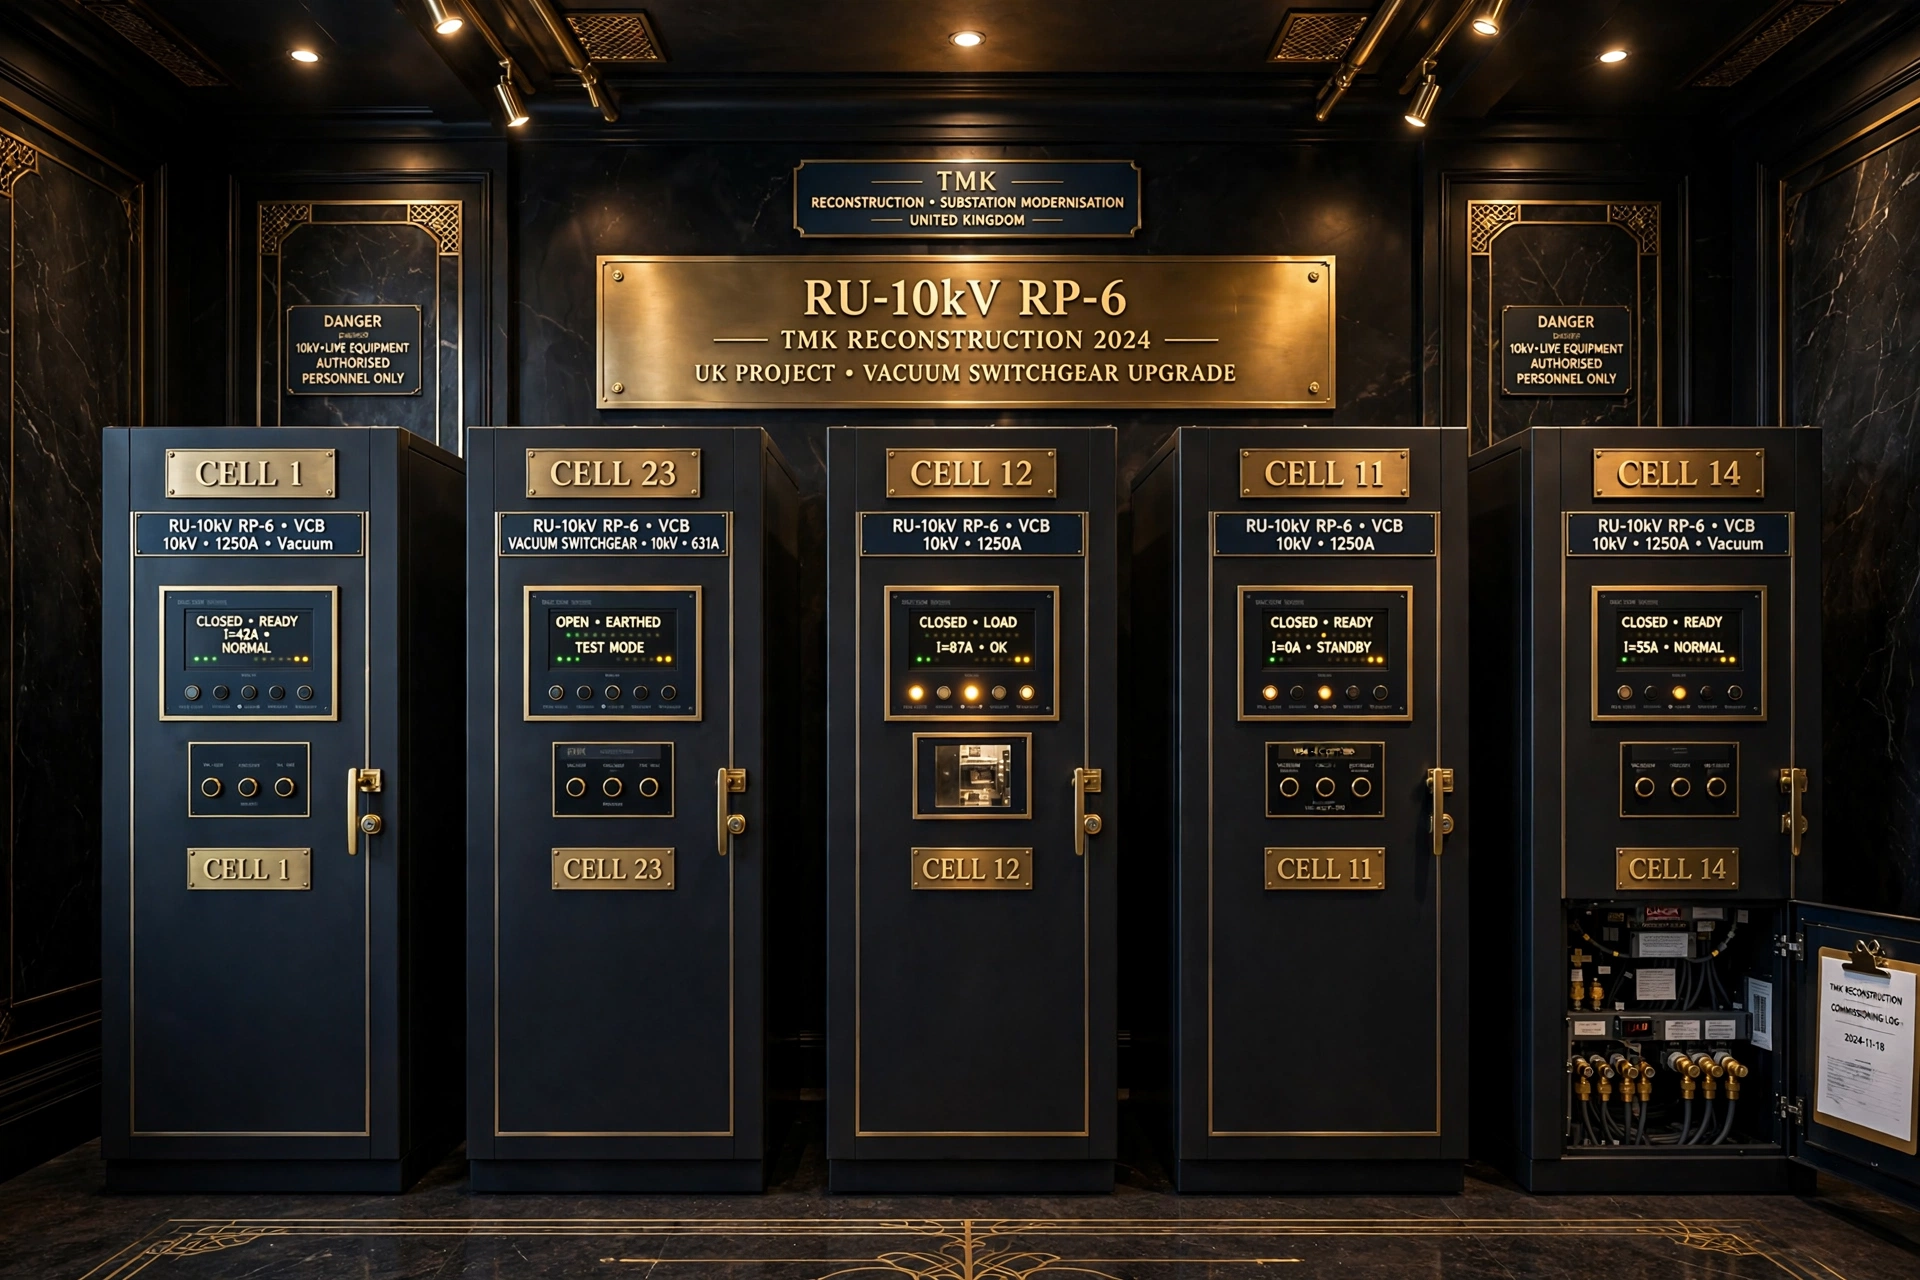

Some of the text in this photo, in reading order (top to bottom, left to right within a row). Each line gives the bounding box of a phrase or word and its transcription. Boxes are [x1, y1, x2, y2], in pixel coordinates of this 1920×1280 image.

[936, 170, 997, 192] TMK
[811, 196, 1124, 209] RECONSTRUCTION SUBSTATION MODERNISATION
[909, 213, 1026, 227] UNITED KINGDOM
[804, 278, 1127, 318] RU-10kV RP-6
[324, 314, 382, 328] DANGER
[1538, 315, 1594, 329] DANGER
[781, 328, 1151, 351] TMK RECONSTRUCTION 2024
[349, 342, 410, 354] EQUIPMENT
[1563, 343, 1624, 355] EQUIPMENT
[316, 357, 391, 369] AUTHORISED
[1530, 358, 1602, 369] AUTHORISED
[302, 372, 405, 384] PERSONNEL ONLY
[695, 363, 1237, 386] UK PROJECT VACUUM SWITCHGEAR UPGRADE
[1516, 373, 1617, 385] PERSONNEL ONLY
[196, 460, 303, 487] CELL 1
[550, 460, 677, 487] CELL 23
[910, 460, 1033, 487] CELL 12
[1264, 460, 1384, 487] CELL 11
[1617, 460, 1741, 487] CELL 14
[169, 518, 326, 533] RU-10kV RP-6 VCB
[533, 518, 690, 533] RU-10kV RP-6 VCB
[892, 518, 1050, 533] RU-10kV RP-6 VCB
[1246, 518, 1403, 533] RU-10kV RP-6 VCB
[1598, 518, 1755, 533] RU-10kV RP-6 VCB
[163, 537, 333, 551] 10kV 1250A Vacuum
[508, 536, 720, 551] VACUUM SWITCHGEAR 10kV 631A
[923, 536, 1022, 551] 10kV 1250A
[1276, 536, 1375, 551] 10kV 1250A
[1593, 536, 1764, 551] 10kV 1250A Vacuum
[196, 615, 298, 628] CLOSED READY
[555, 616, 661, 628] OPEN EARTHED
[919, 616, 1018, 628] CLOSED LOAD
[1270, 616, 1373, 628] CLOSED READY
[1621, 616, 1723, 628] CLOSED READY
[222, 642, 272, 654] NORMAL
[575, 641, 645, 654] TEST MODE
[936, 641, 1008, 654] I=87A OK
[1272, 641, 1372, 654] I=0A STANDBY
[1624, 641, 1724, 653] I=55A NORMAL
[203, 858, 289, 880] CELL 1
[563, 858, 663, 880] CELL 23
[922, 858, 1020, 880] CELL 12
[1277, 858, 1371, 880] CELL 11
[1629, 858, 1726, 880] CELL 14
[1830, 983, 1903, 1005] TMK RECONSTRUCTION
[1845, 1033, 1884, 1051] 2024-11-18
